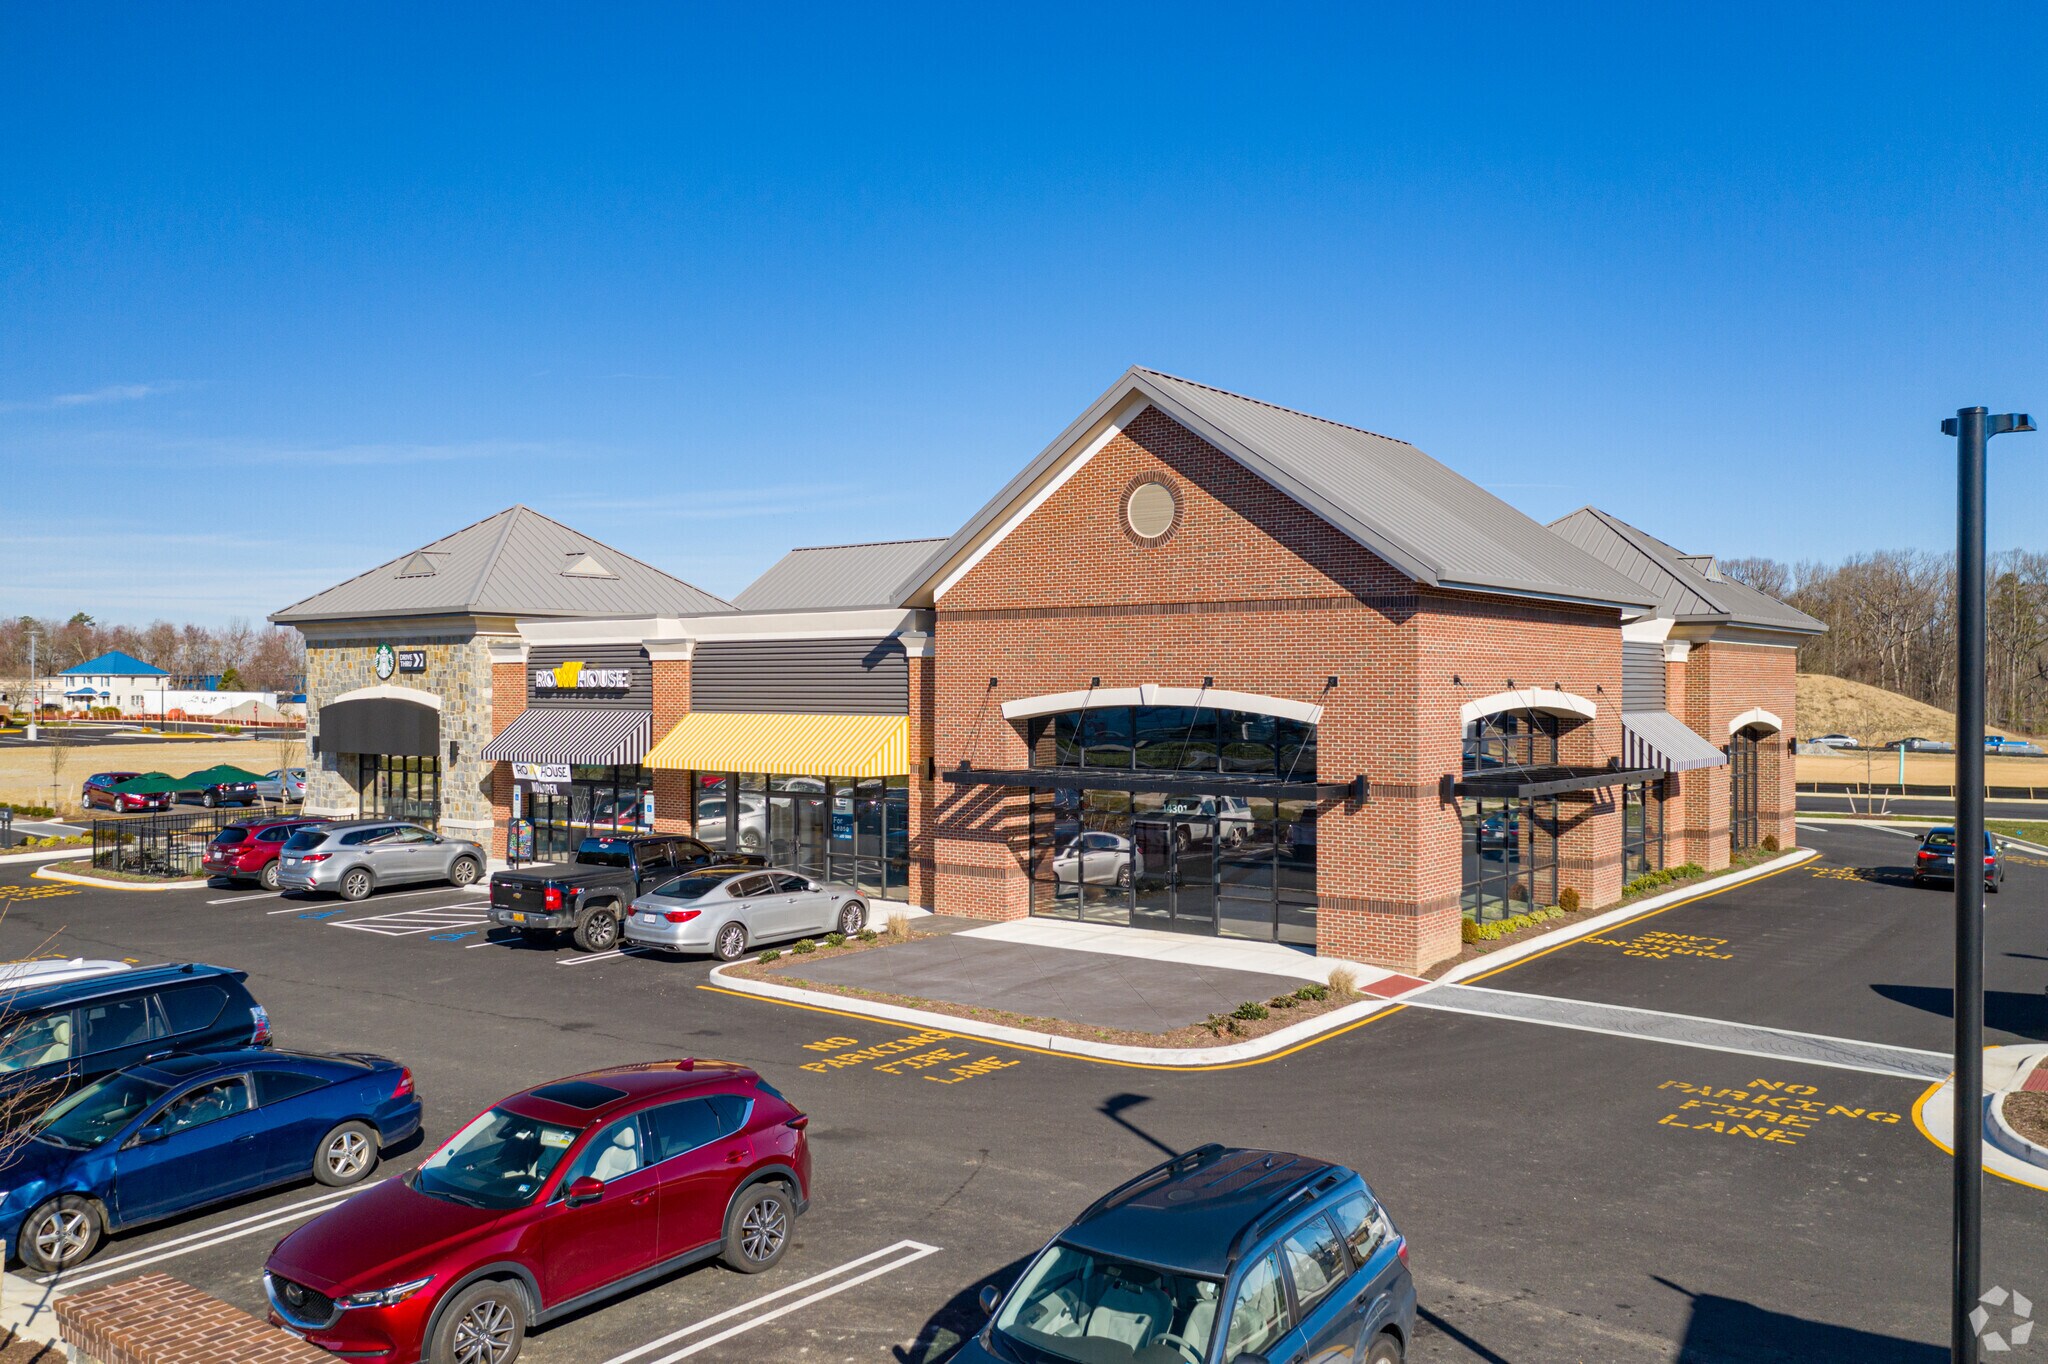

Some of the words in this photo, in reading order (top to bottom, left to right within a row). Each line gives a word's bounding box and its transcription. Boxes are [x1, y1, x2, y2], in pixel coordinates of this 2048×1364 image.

[400, 660, 413, 668] THRU
[541, 766, 568, 778] HOUSE
[1163, 804, 1188, 814] 14301
[833, 816, 843, 824] For
[833, 824, 850, 833] Lease
[799, 1032, 948, 1073] PARKING
[802, 1036, 859, 1052] NO
[873, 1048, 970, 1075] FIRE
[923, 1056, 1021, 1084] LANE
[1747, 1078, 1819, 1095] NO
[1657, 1080, 1902, 1124] PARKING
[1679, 1099, 1820, 1129] FIRE
[1657, 1113, 1806, 1145] LANE
